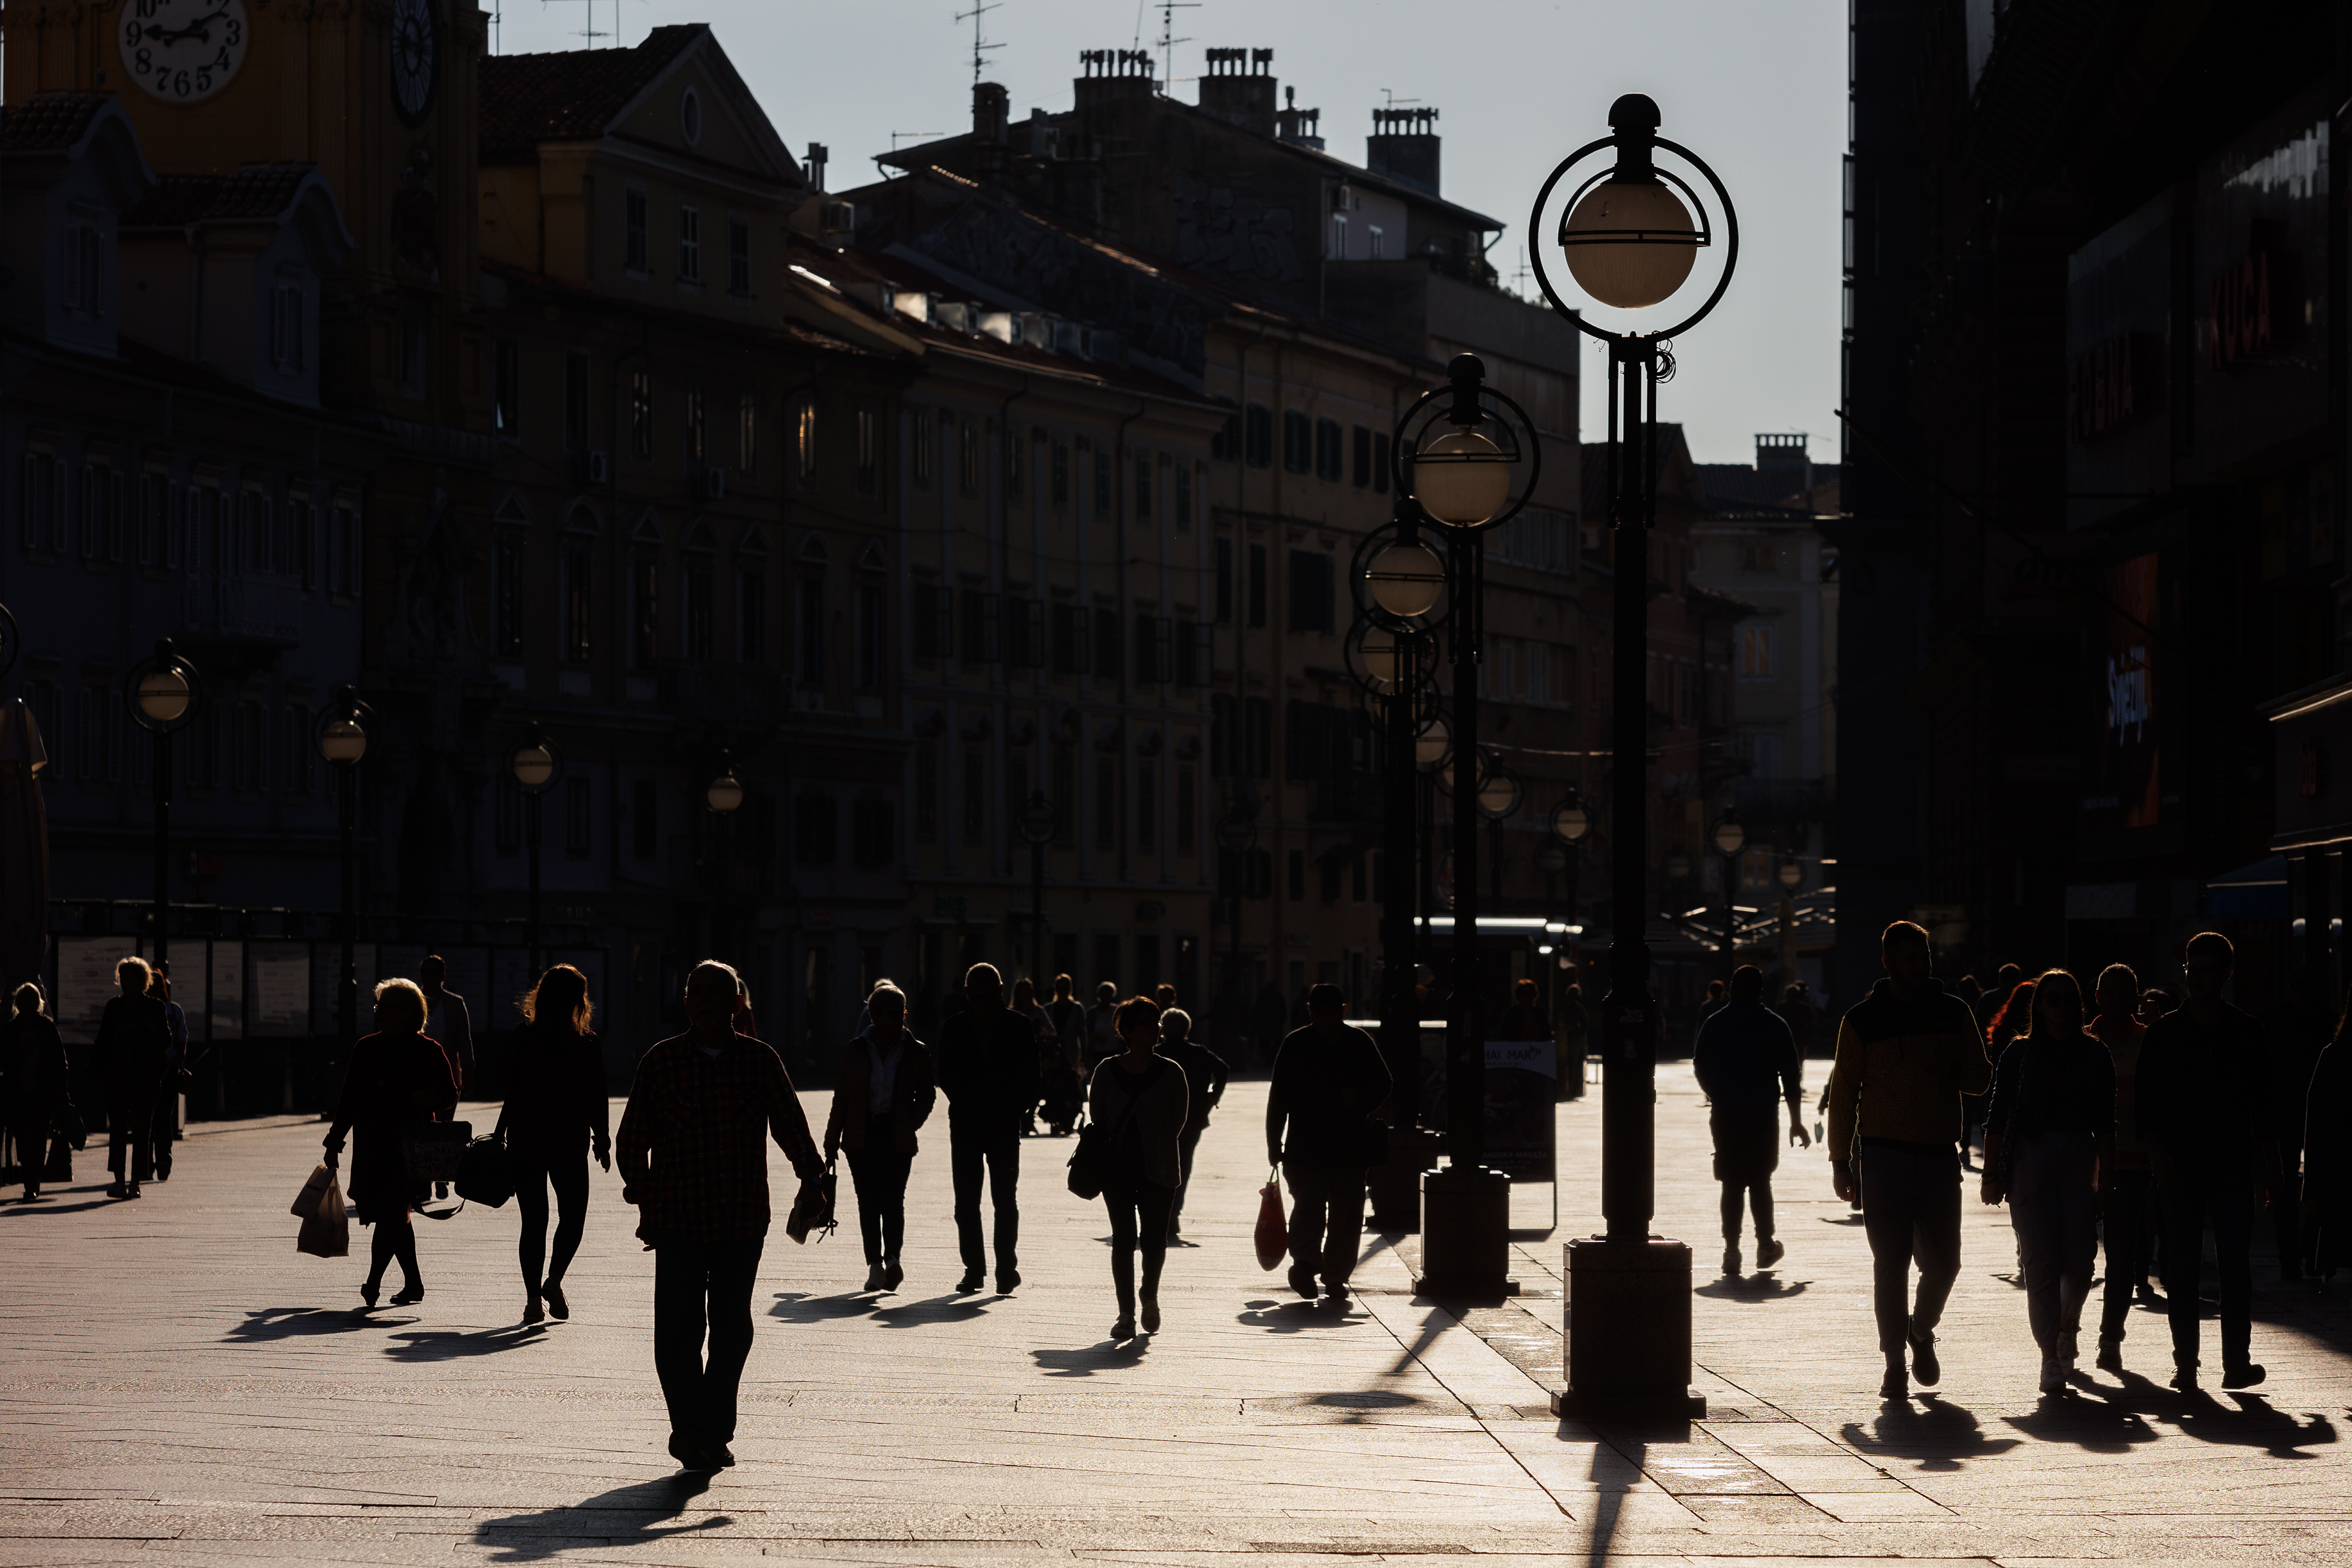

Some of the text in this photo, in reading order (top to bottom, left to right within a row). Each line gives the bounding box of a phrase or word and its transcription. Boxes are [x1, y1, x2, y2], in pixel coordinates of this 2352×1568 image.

[126, 21, 142, 46] 9
[226, 19, 240, 46] 3
[135, 48, 151, 75] 8
[215, 46, 230, 71] 4
[156, 66, 172, 92] 7
[174, 70, 191, 96] 6
[197, 64, 212, 91] 5
[2069, 331, 2133, 444] ROBNA
[1484, 1049, 1501, 1060] HAI
